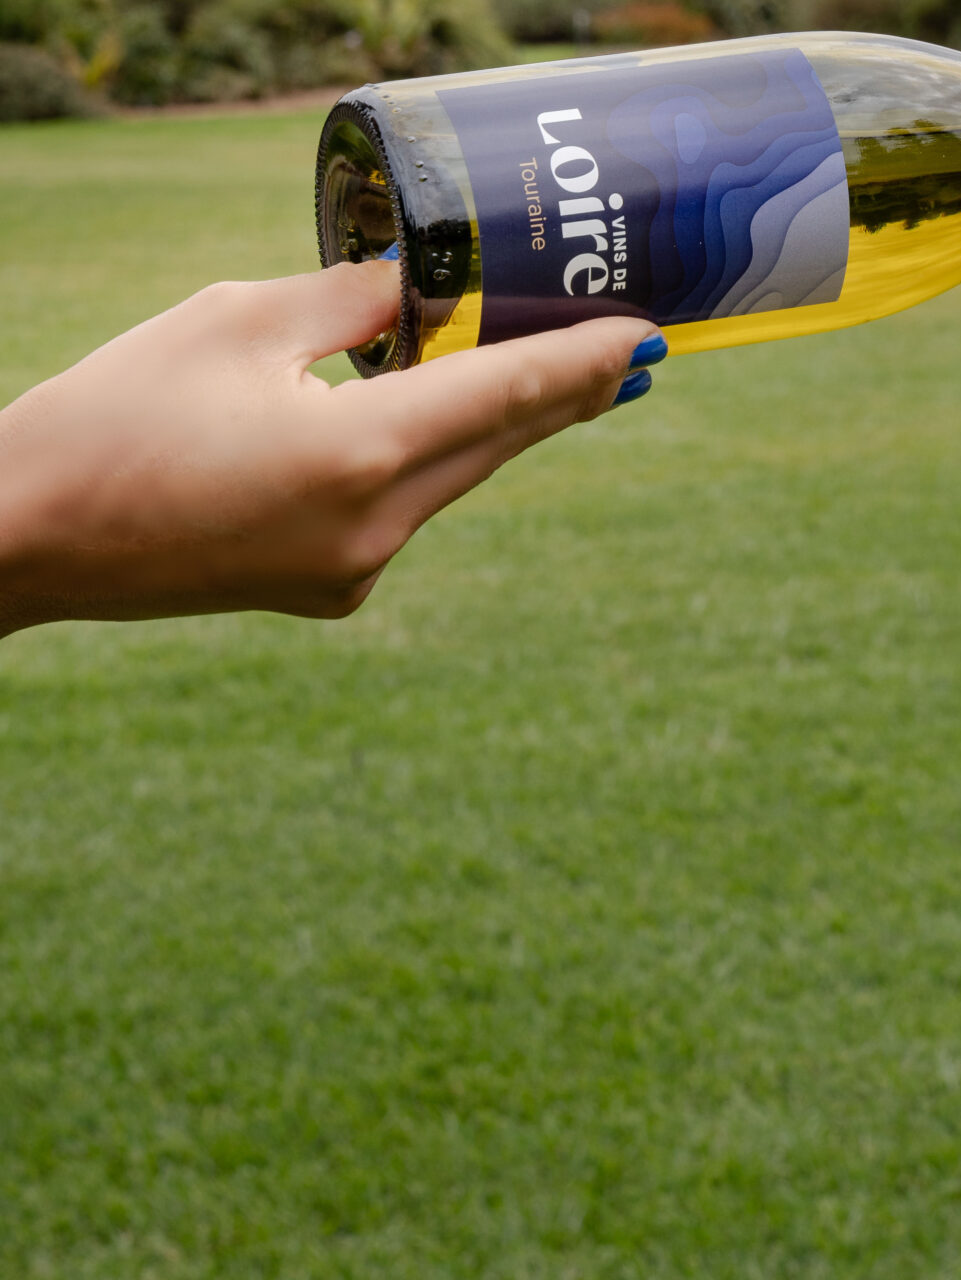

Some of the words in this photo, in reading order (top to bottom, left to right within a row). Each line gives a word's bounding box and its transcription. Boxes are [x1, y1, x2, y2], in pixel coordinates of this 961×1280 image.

[519, 157, 547, 251] Touraine
[537, 108, 623, 296] Loire
[612, 215, 627, 264] VINS
[612, 268, 627, 291] DE
